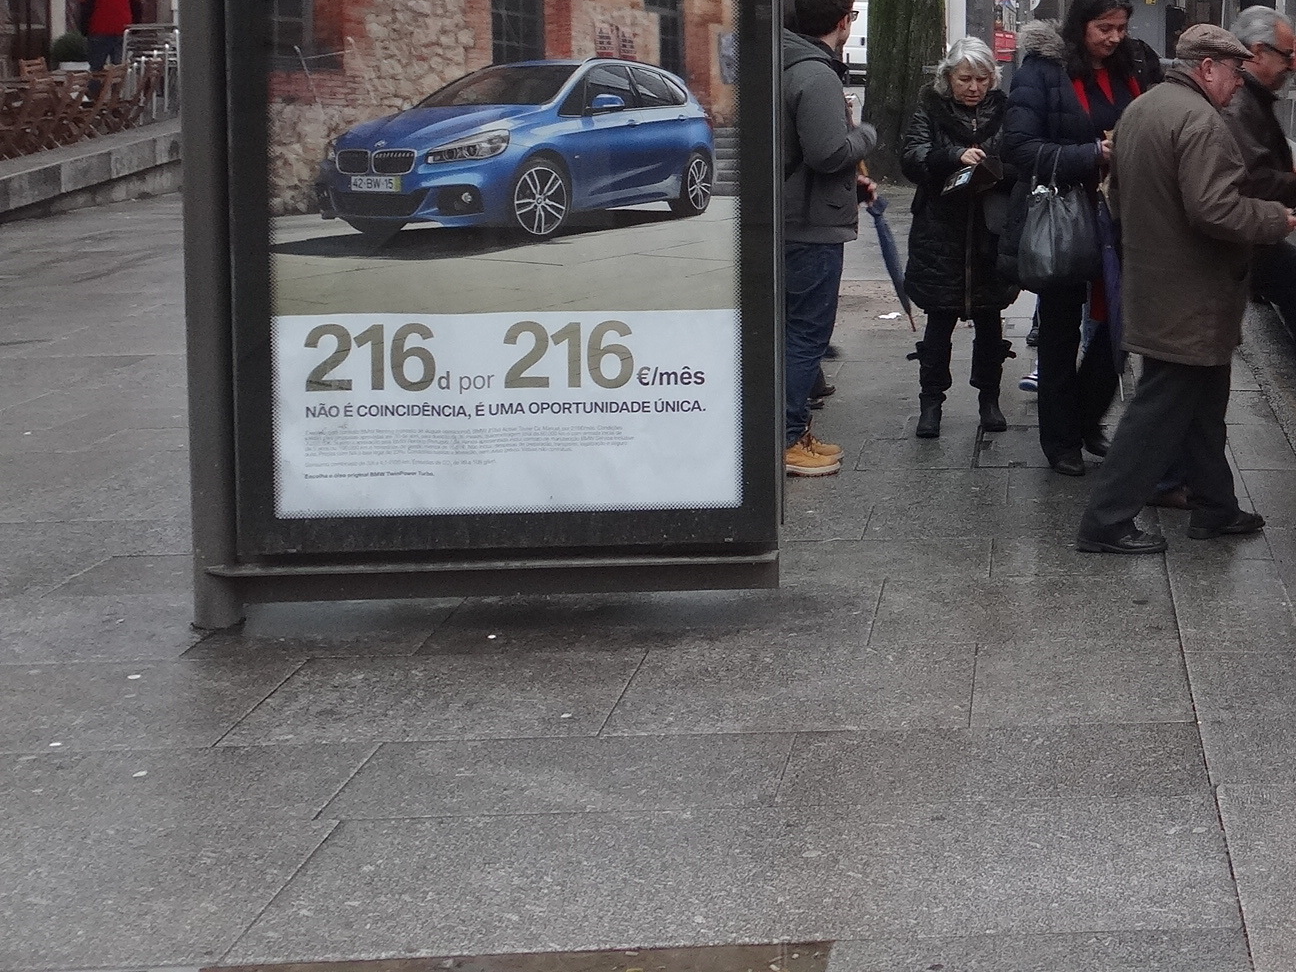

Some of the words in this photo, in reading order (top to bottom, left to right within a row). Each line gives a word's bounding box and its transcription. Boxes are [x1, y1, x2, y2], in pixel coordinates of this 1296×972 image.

[458, 373, 495, 394] por
[305, 403, 340, 418] NÃO
[343, 402, 353, 417] É
[356, 402, 472, 419] COINCIDÊNCIA,
[475, 402, 485, 417] É
[488, 403, 526, 416] UMA
[528, 401, 651, 415] OPORTUNIDADE
[654, 398, 707, 413] ÚNICA.
